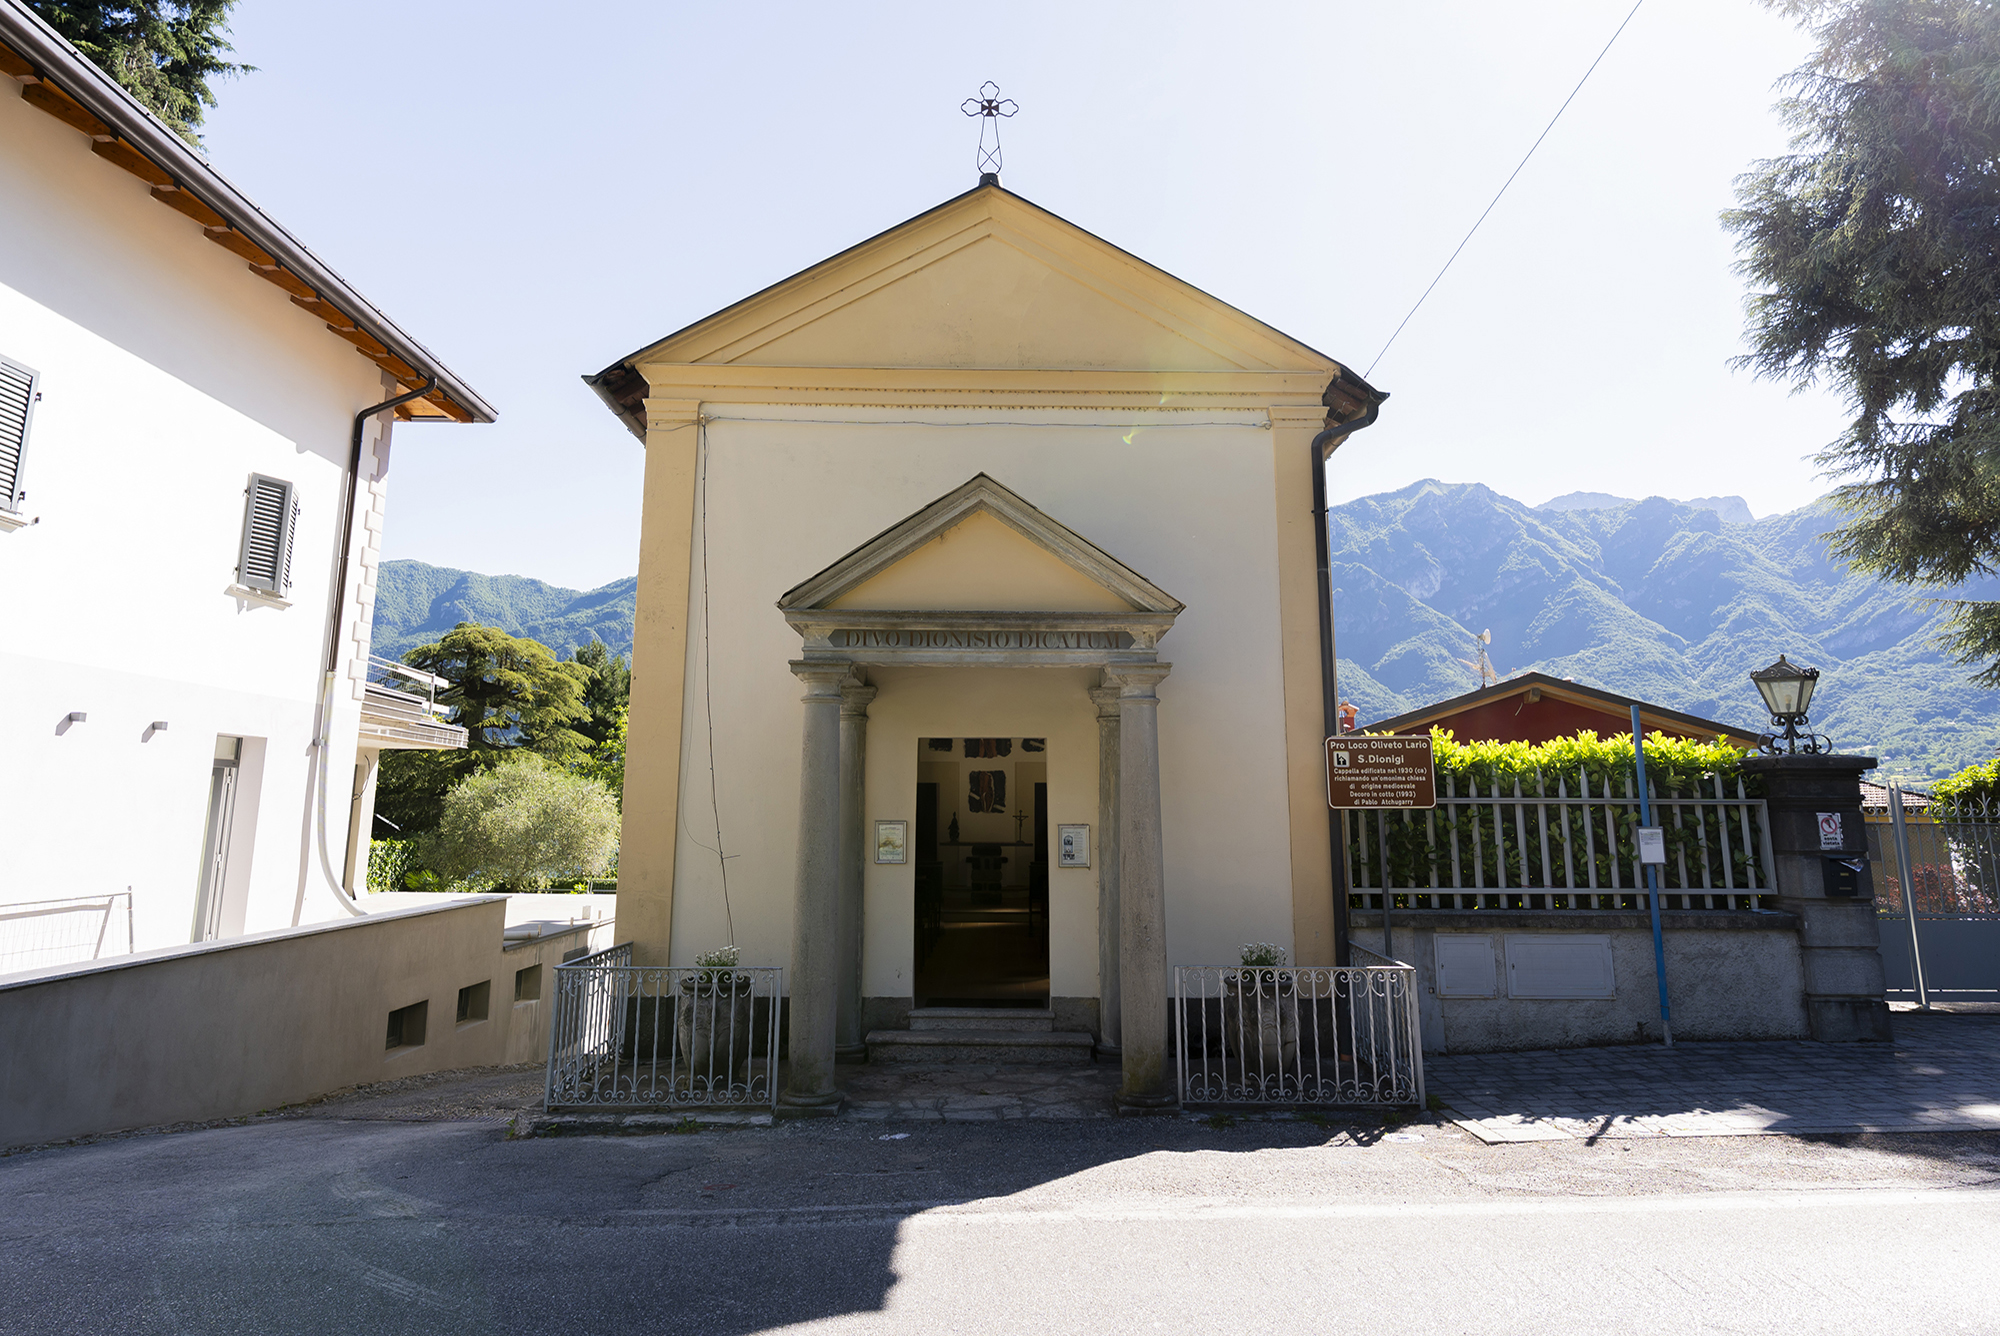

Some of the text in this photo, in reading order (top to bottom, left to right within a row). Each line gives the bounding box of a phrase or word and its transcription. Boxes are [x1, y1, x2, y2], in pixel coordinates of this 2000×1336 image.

[845, 631, 1120, 649] DIVO DIONISIO DICATUM
[1371, 741, 1402, 749] Oliveto
[1358, 755, 1404, 764] S.Dionigi
